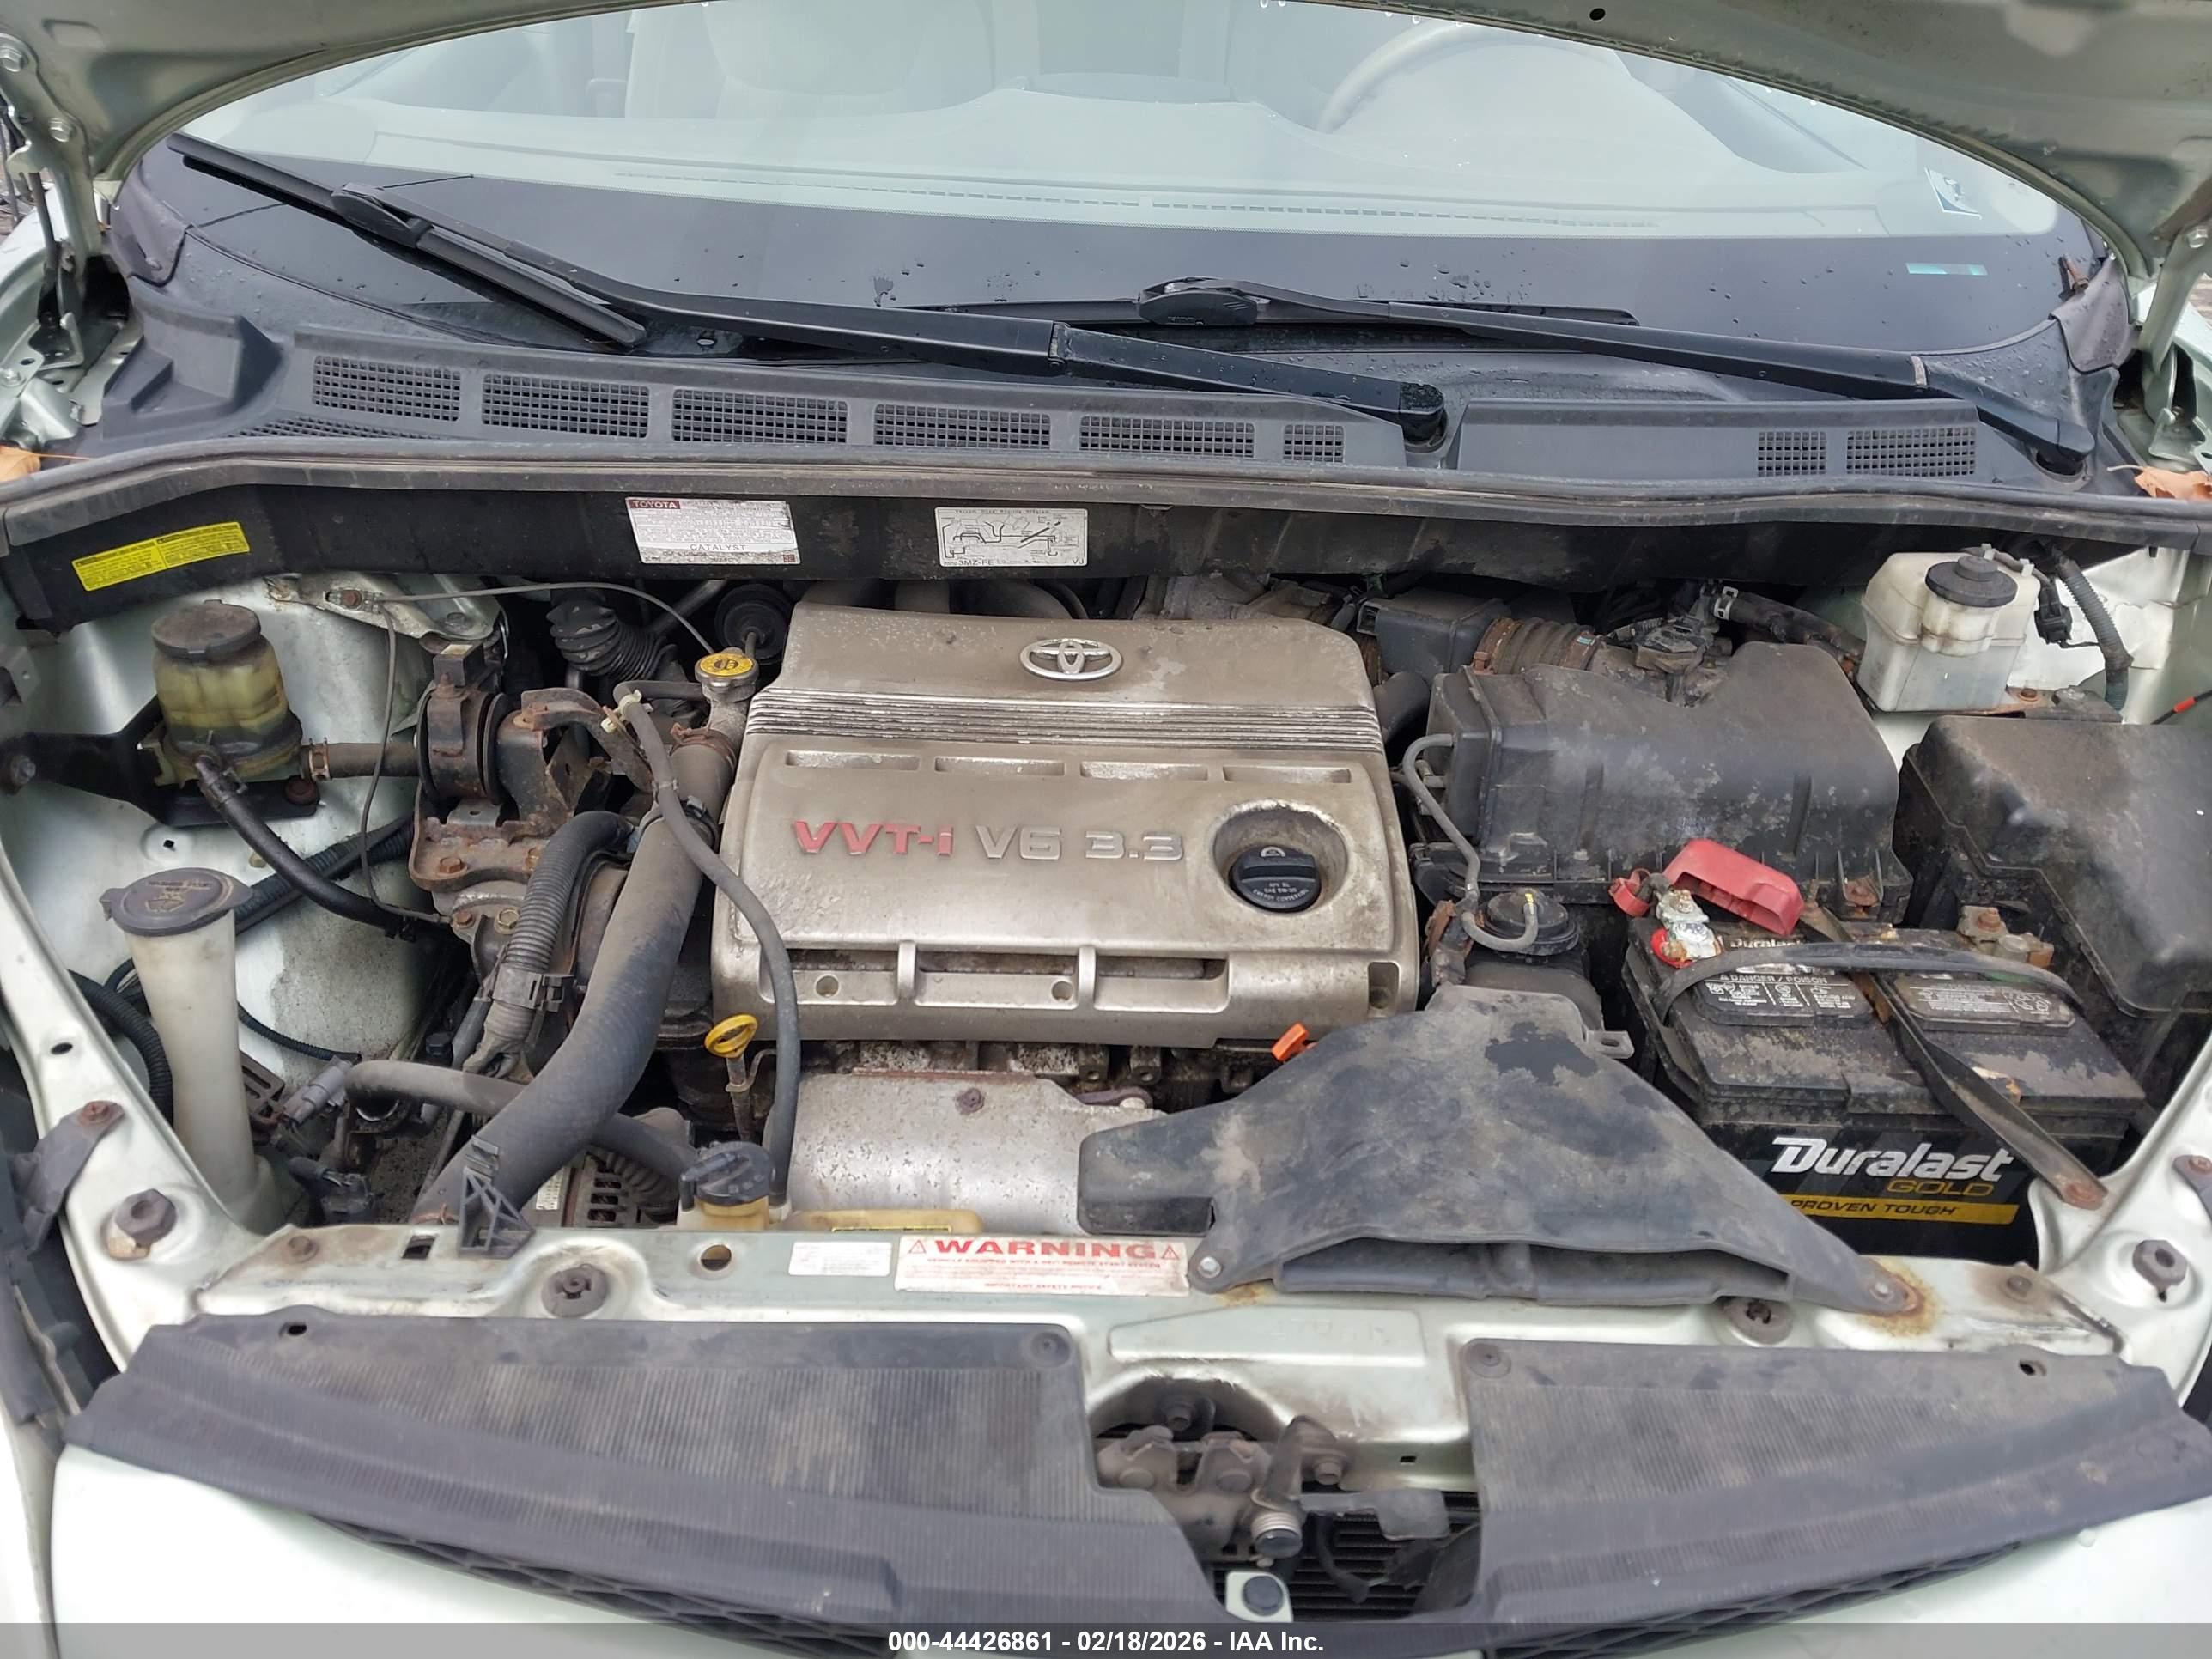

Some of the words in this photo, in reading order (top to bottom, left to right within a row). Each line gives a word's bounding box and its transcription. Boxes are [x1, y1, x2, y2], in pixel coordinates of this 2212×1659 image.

[632, 501, 678, 509] TOYOTA
[793, 820, 954, 855] VVT-i
[975, 824, 1062, 860] V6
[1085, 830, 1184, 860] 3.3
[1786, 976, 1827, 985] POISON
[1771, 1137, 2014, 1182] Duralast
[1887, 1180, 1994, 1196] GOLD
[1885, 1204, 1958, 1216] TOUGH
[935, 1239, 1156, 1260] WARNING
